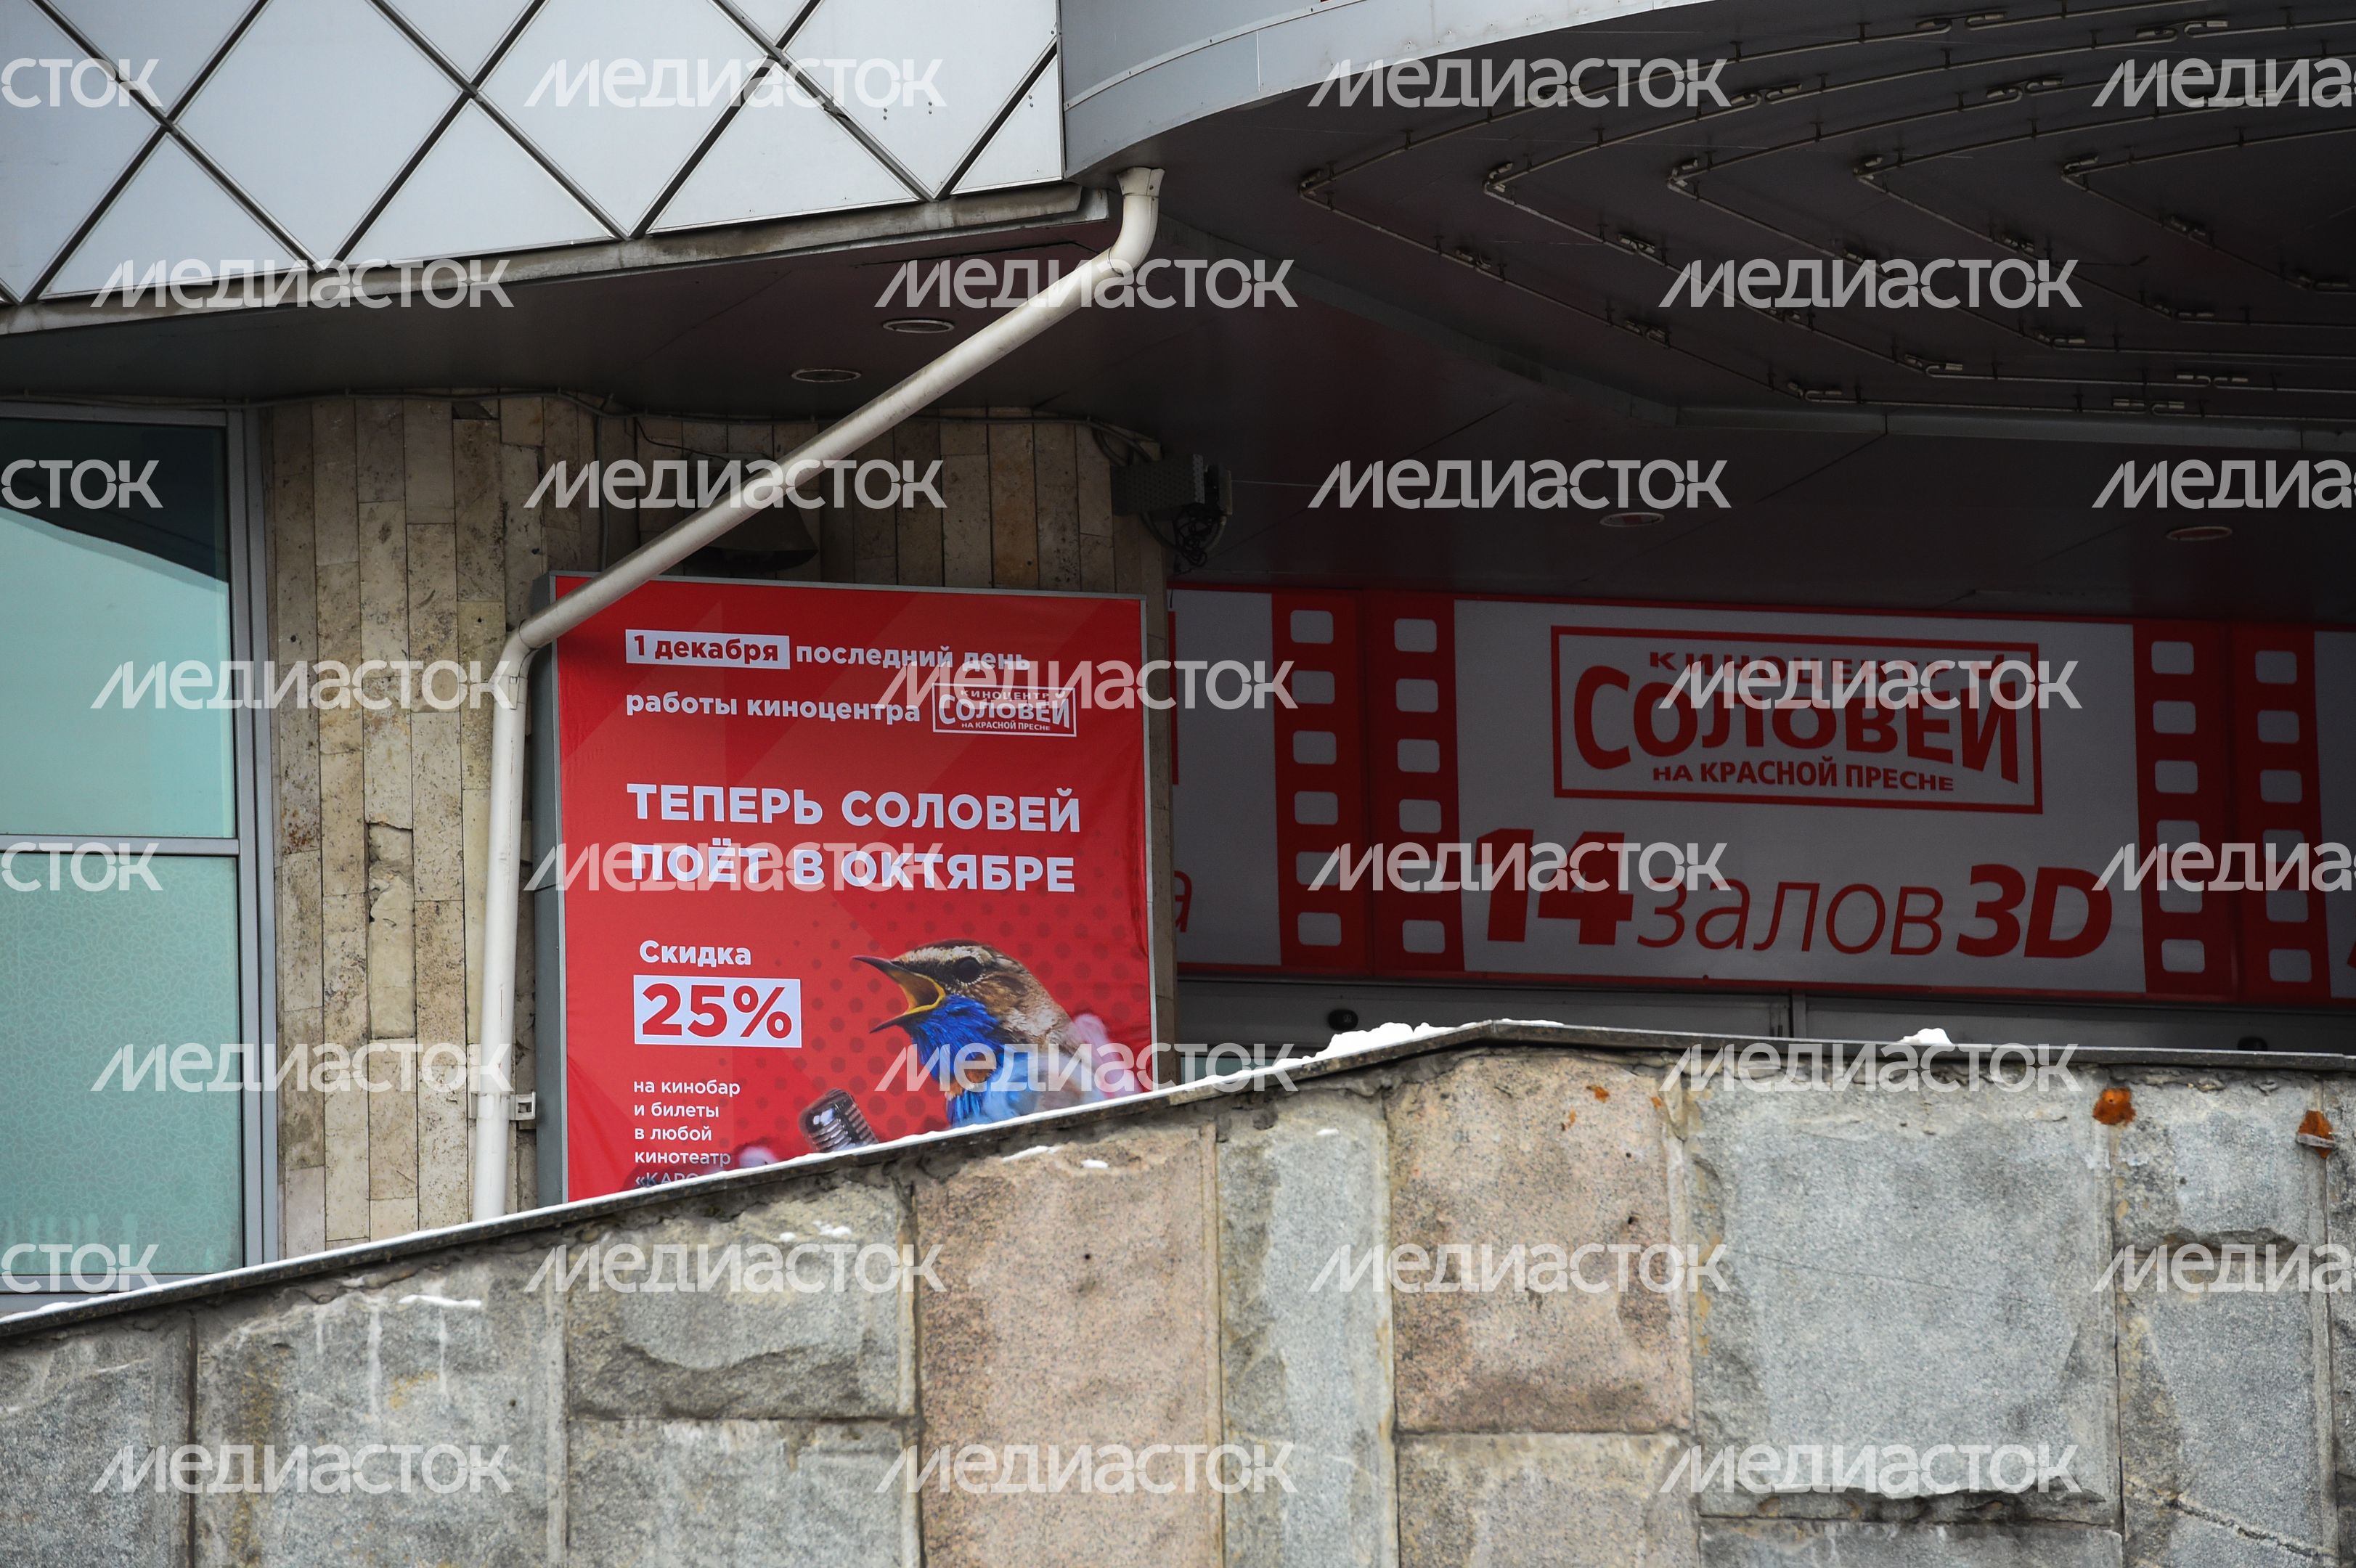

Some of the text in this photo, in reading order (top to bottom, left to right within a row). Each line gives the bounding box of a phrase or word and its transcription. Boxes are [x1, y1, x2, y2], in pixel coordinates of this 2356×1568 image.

[634, 634, 1031, 671] 1 декабря последний день
[626, 691, 920, 724] работы киноцентра
[939, 691, 1069, 729] СОЛОВЕЙ
[961, 690, 1050, 701] КИНОЦЕНТР
[975, 720, 1016, 730] КРАСНОЙ
[1018, 722, 1051, 731] ПРЕСНЕ
[1652, 756, 1953, 791] НА КРАСНОЙ ПРЕСНЕ
[627, 783, 1080, 833] ТЕПЕРЬ СОЛОВЕЙ
[632, 837, 1075, 893] ПОЁТ В ОКТЯБРЕ
[639, 940, 751, 967] Скидка
[642, 984, 793, 1040] 25%
[634, 1079, 741, 1097] на кинобар
[634, 1102, 720, 1117] и билеты
[635, 1126, 712, 1140] в любой
[635, 1152, 731, 1167] кинотеатр
